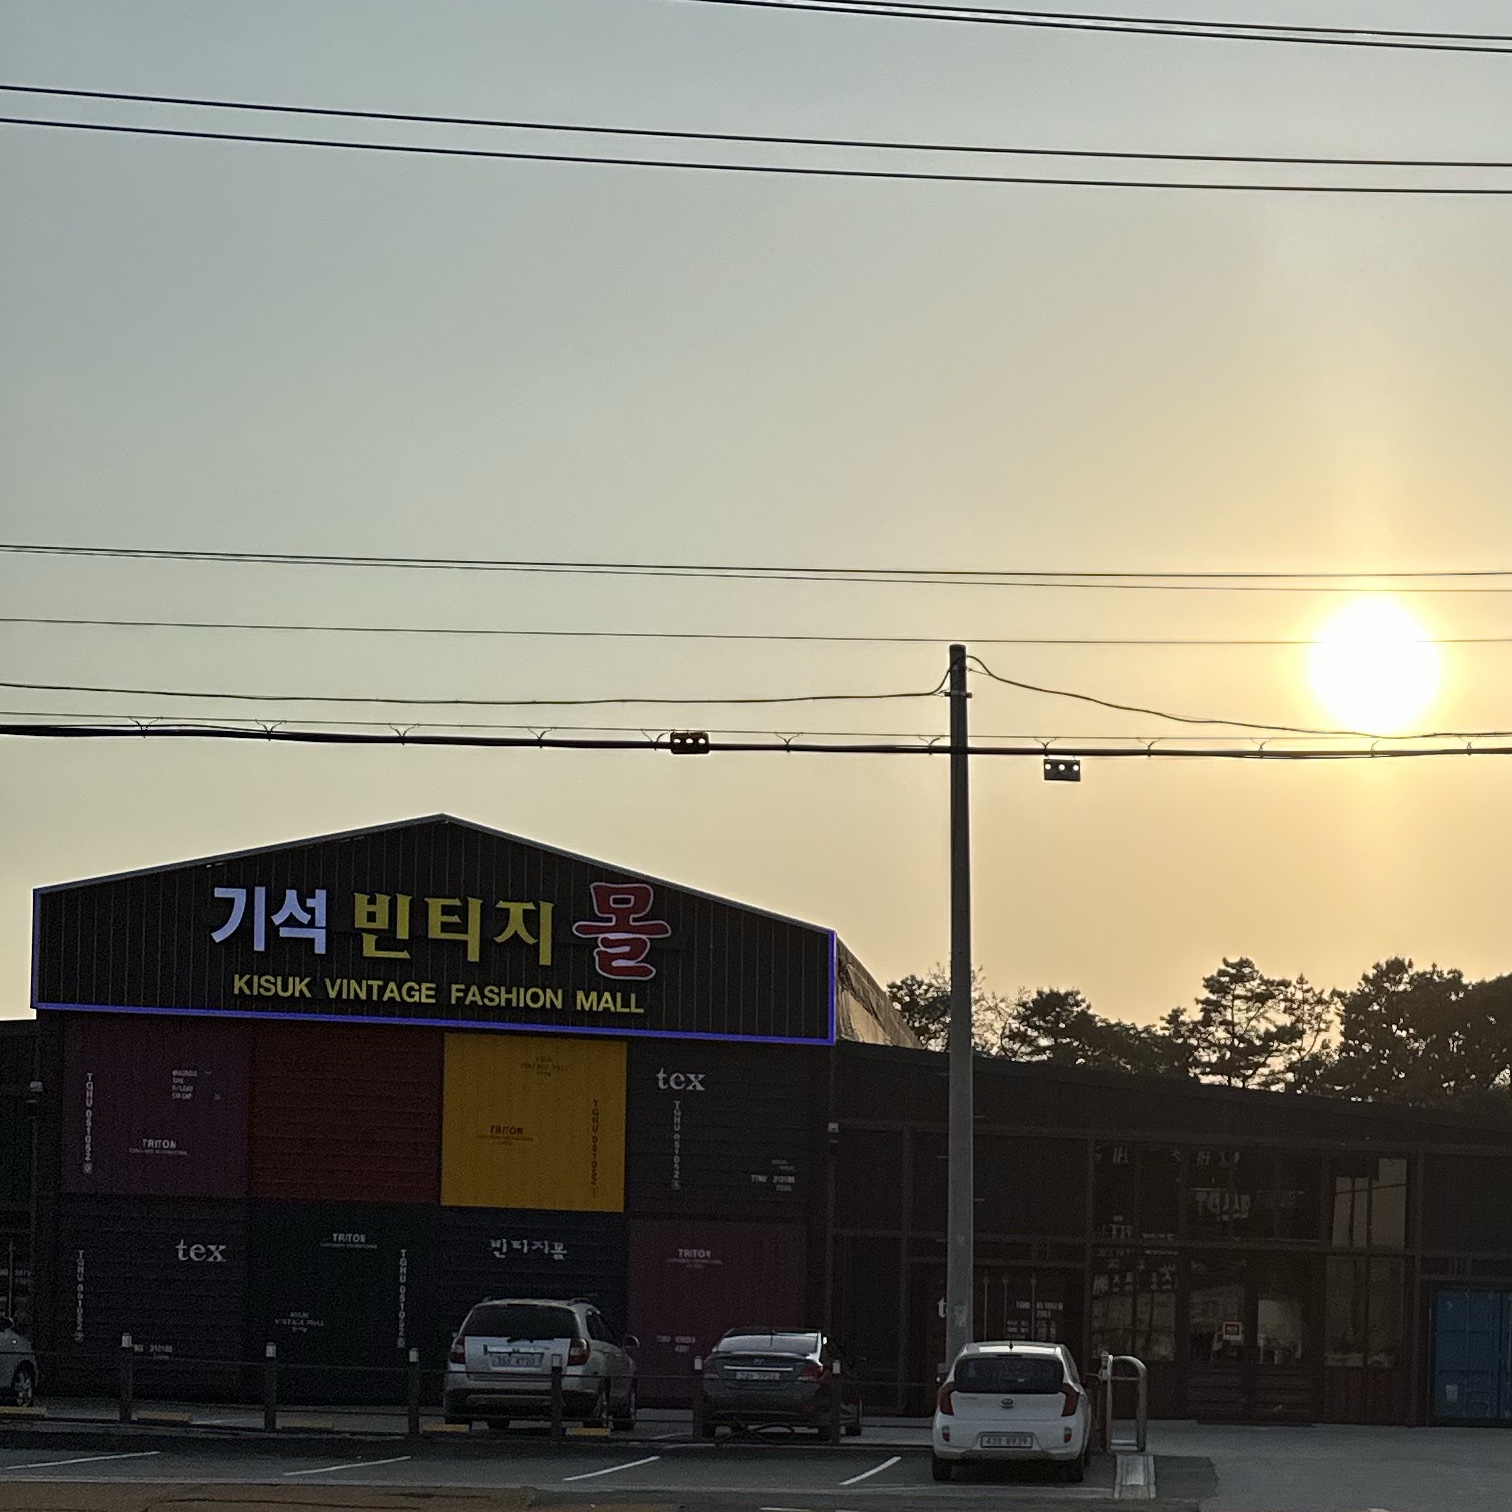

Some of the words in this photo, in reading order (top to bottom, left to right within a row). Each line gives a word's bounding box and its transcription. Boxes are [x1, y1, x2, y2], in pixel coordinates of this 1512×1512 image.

[211, 885, 327, 955] 기석
[353, 892, 553, 966] 빈티지
[571, 881, 671, 980] 몰
[232, 974, 313, 998] KISUK
[325, 977, 436, 1005] VINTAGE
[449, 983, 563, 1009] FASHION
[575, 989, 644, 1013] MALL
[656, 1068, 706, 1091] tex
[175, 1238, 228, 1263] tex
